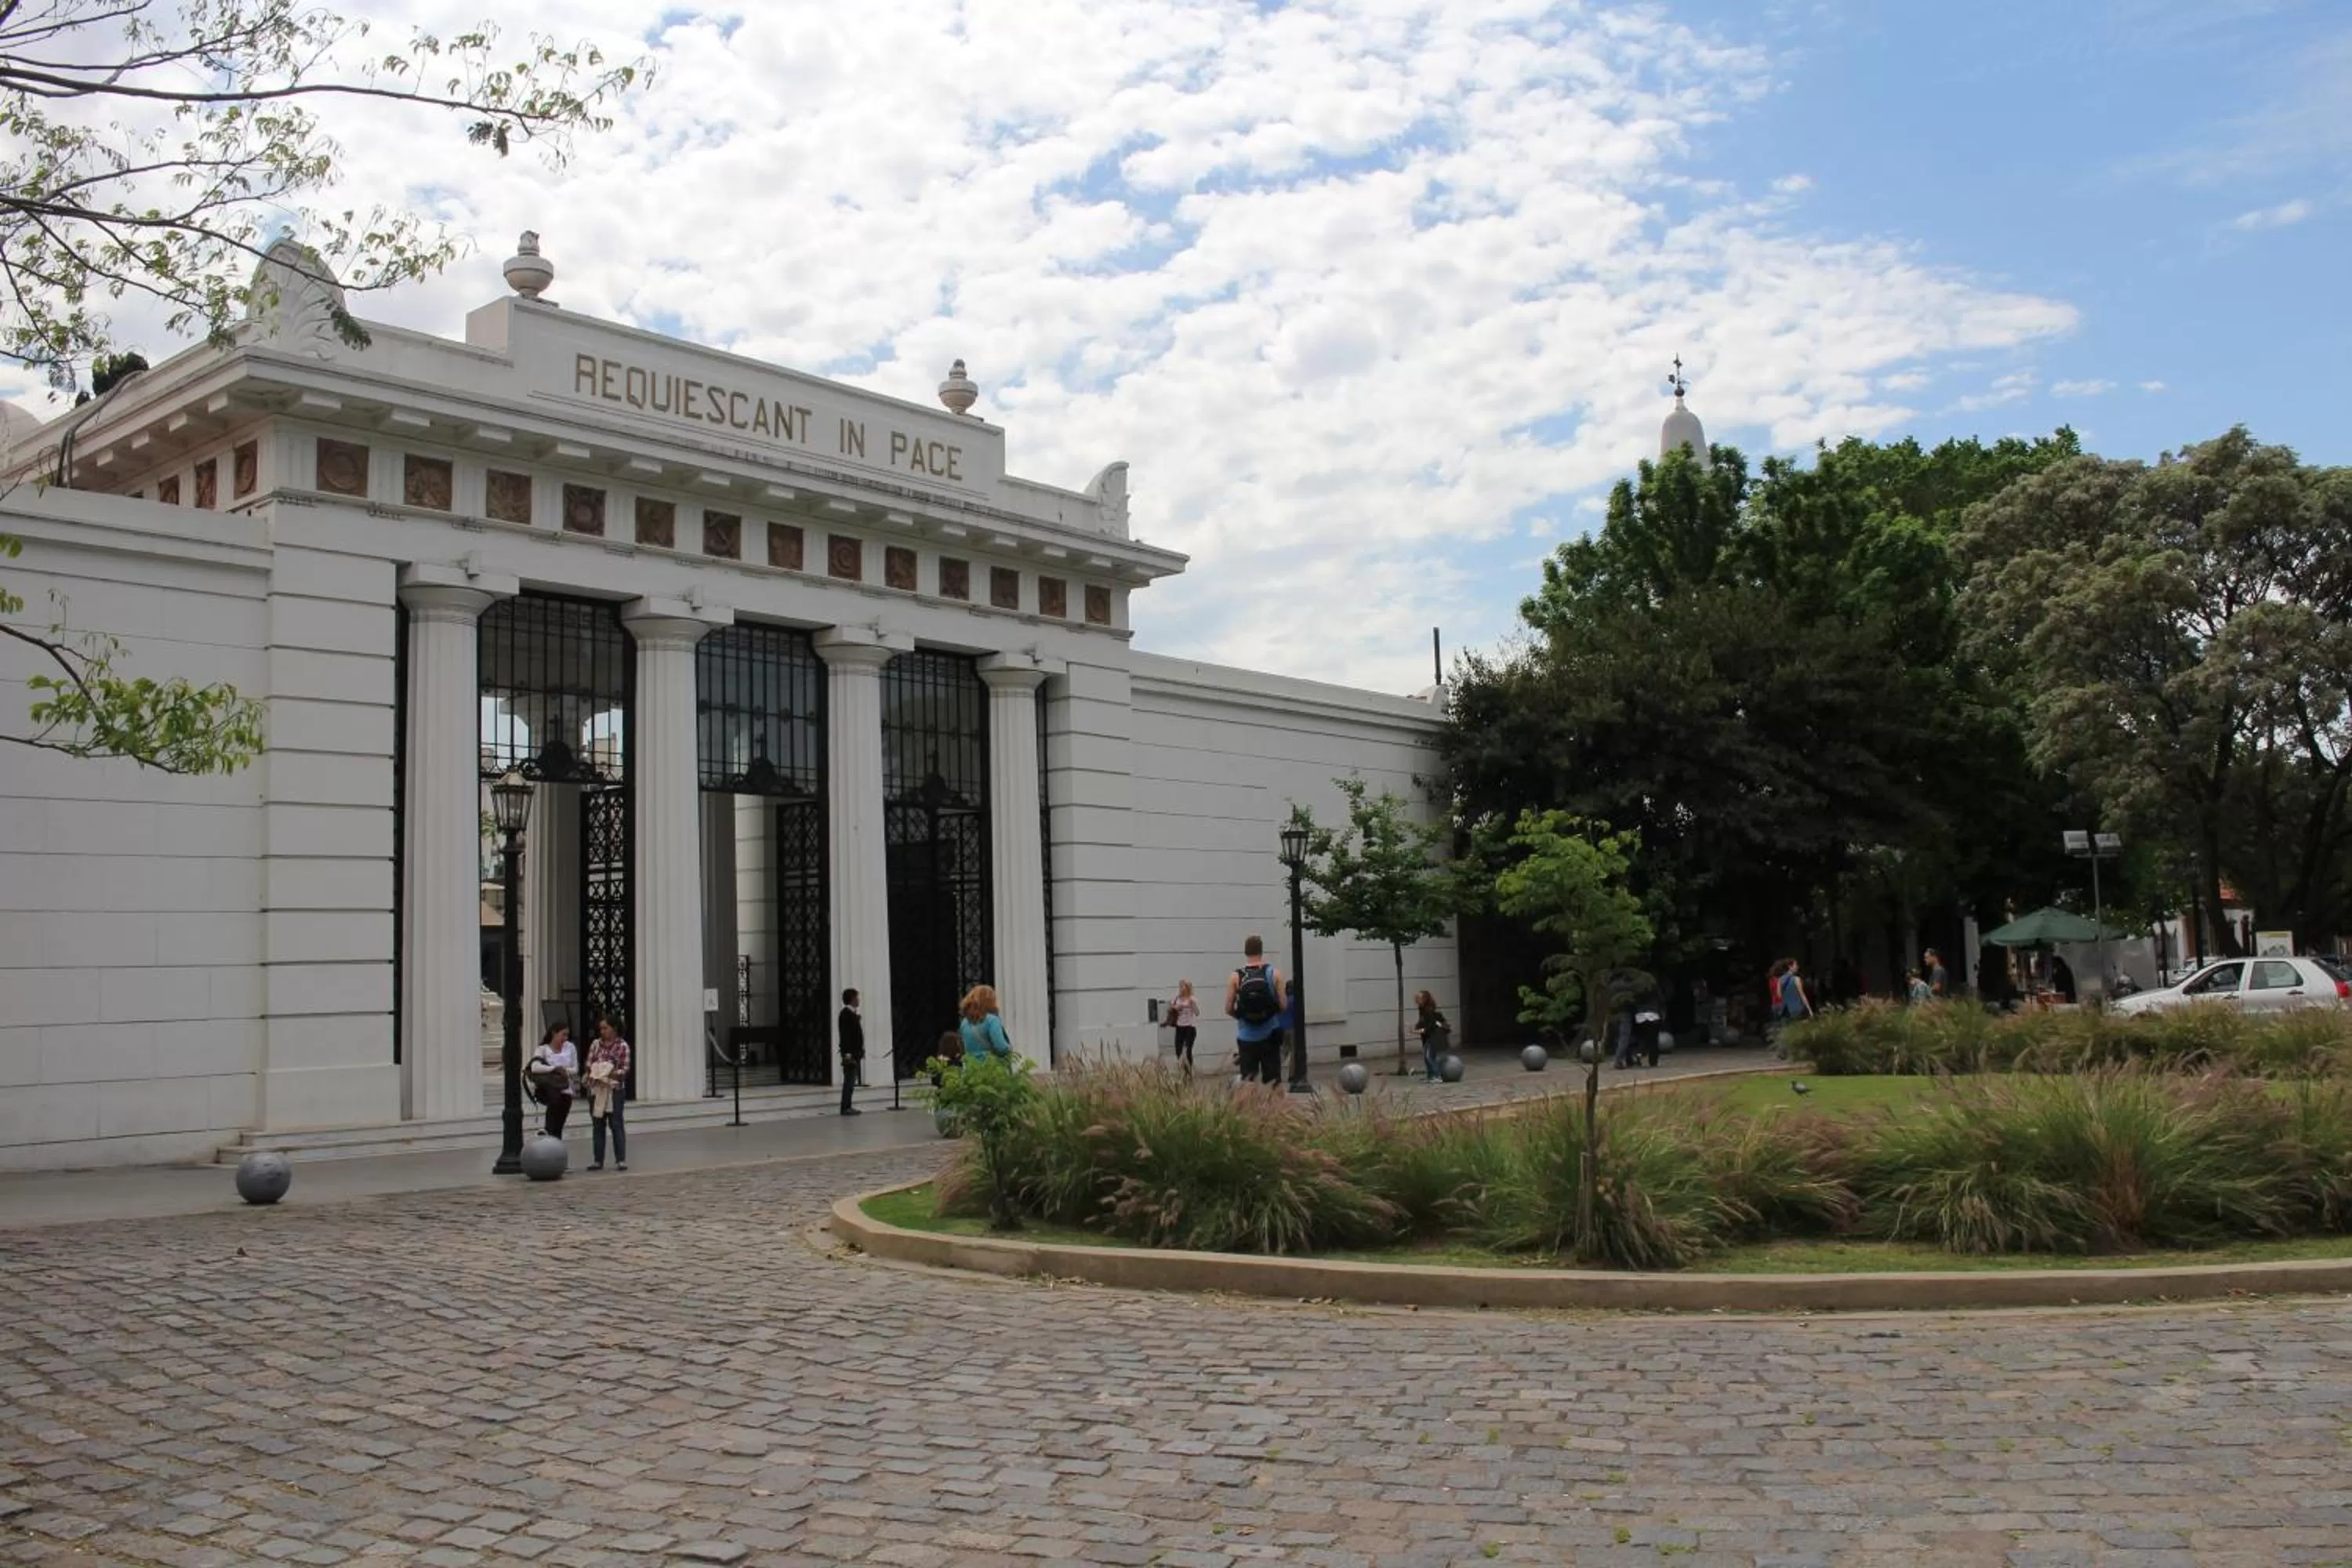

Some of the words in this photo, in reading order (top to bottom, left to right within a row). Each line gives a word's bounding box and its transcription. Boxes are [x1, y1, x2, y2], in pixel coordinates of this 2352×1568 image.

[575, 353, 812, 444] REQUIESCANT
[839, 417, 865, 458] IN
[891, 430, 963, 481] PACE
